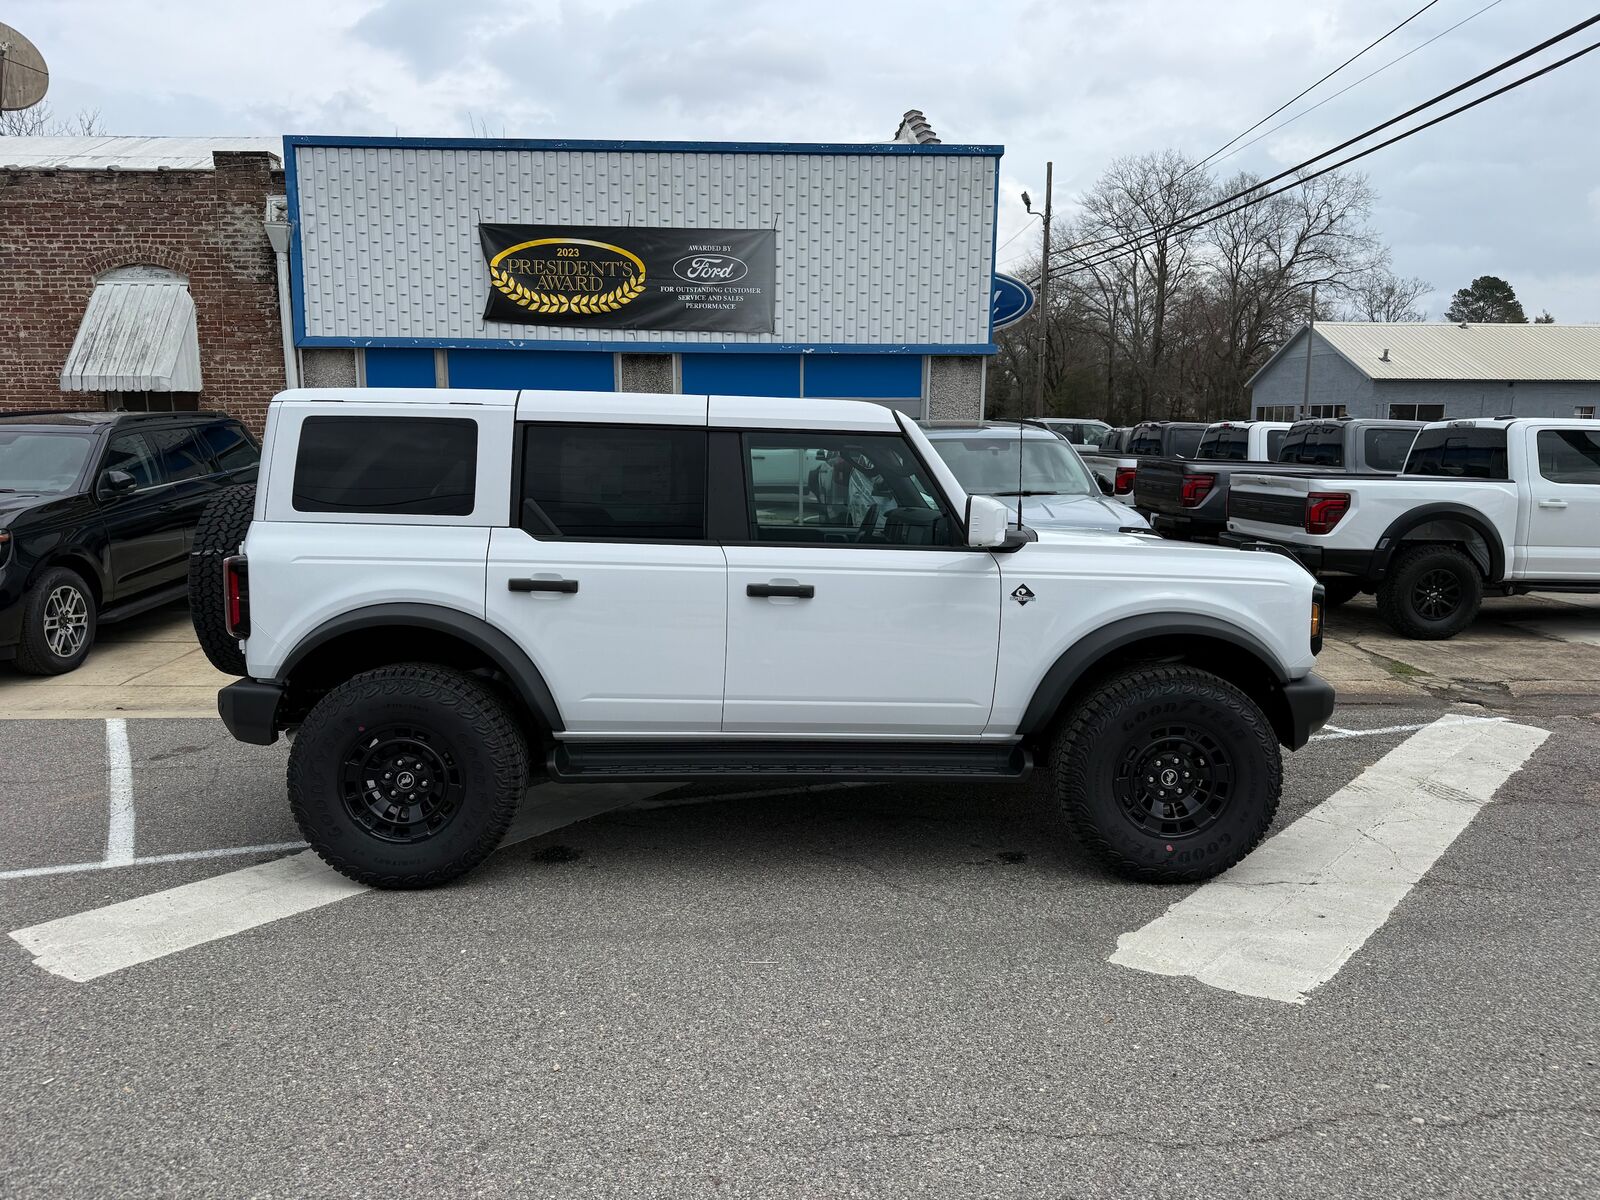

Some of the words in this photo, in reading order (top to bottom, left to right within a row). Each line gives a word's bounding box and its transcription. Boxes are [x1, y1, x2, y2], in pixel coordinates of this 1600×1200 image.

[556, 248, 580, 257] 2023
[506, 258, 633, 277] PRESIDENT'S
[687, 257, 734, 278] Ford
[535, 275, 604, 292] AWARD
[685, 302, 736, 310] PERFORMANCE
